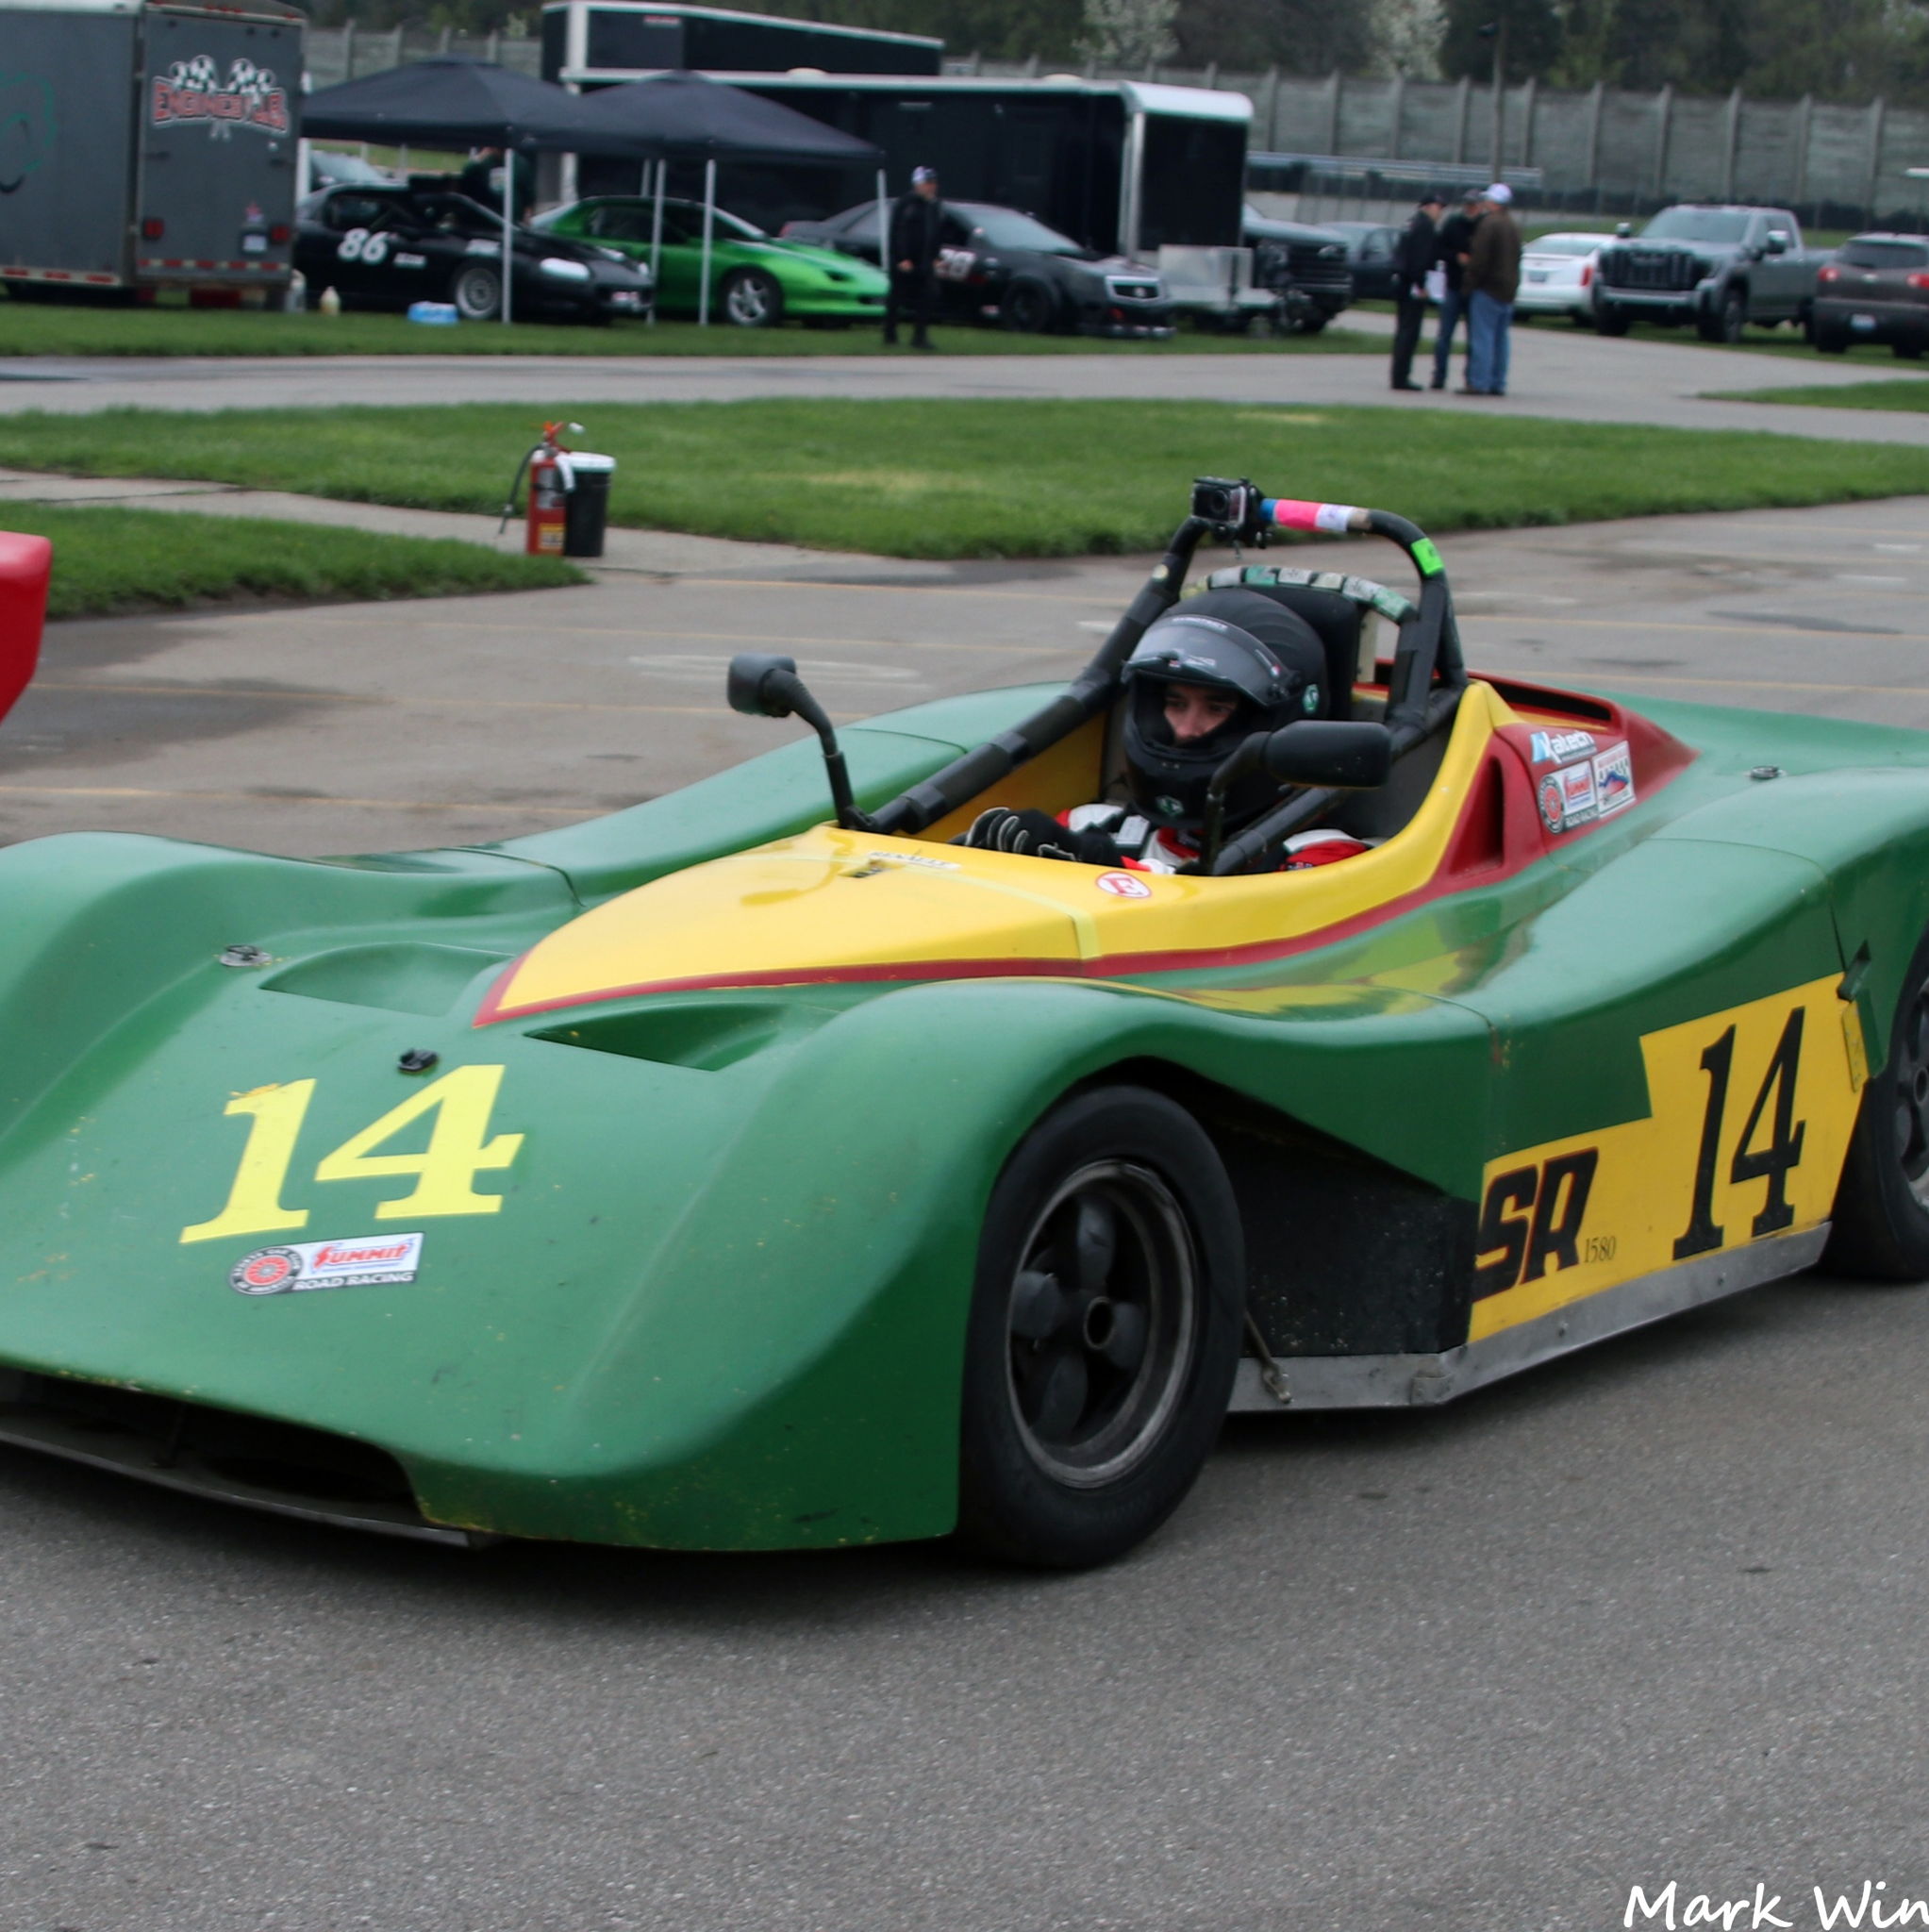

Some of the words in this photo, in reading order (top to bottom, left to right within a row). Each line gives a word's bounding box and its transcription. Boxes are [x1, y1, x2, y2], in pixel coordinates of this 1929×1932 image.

[338, 228, 387, 263] 86
[1672, 1006, 1805, 1260] 14
[179, 1064, 524, 1243] 14
[1584, 1236, 1616, 1263] 1580
[292, 1276, 344, 1291] ROAD
[346, 1272, 414, 1287] RACING
